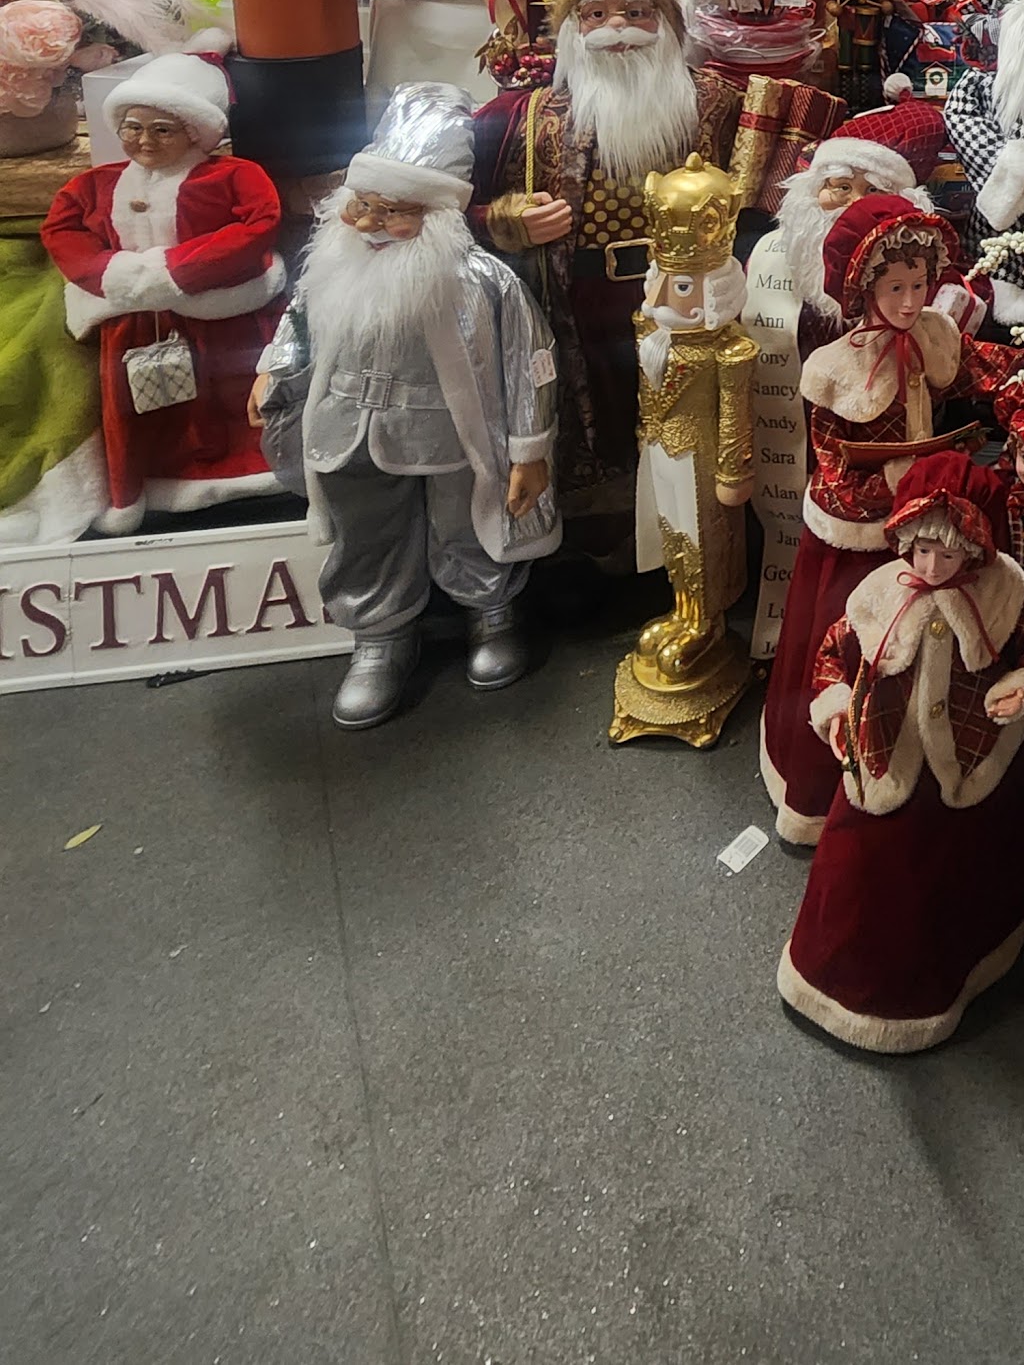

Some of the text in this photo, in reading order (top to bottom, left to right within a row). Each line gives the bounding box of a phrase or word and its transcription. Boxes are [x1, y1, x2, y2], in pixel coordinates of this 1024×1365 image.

[755, 273, 794, 291] Matt
[753, 312, 785, 329] Ann
[760, 352, 790, 367] ony
[755, 415, 797, 433] Andy
[761, 447, 795, 465] Sara
[761, 484, 798, 501] Alan
[0, 559, 334, 660] STMA
